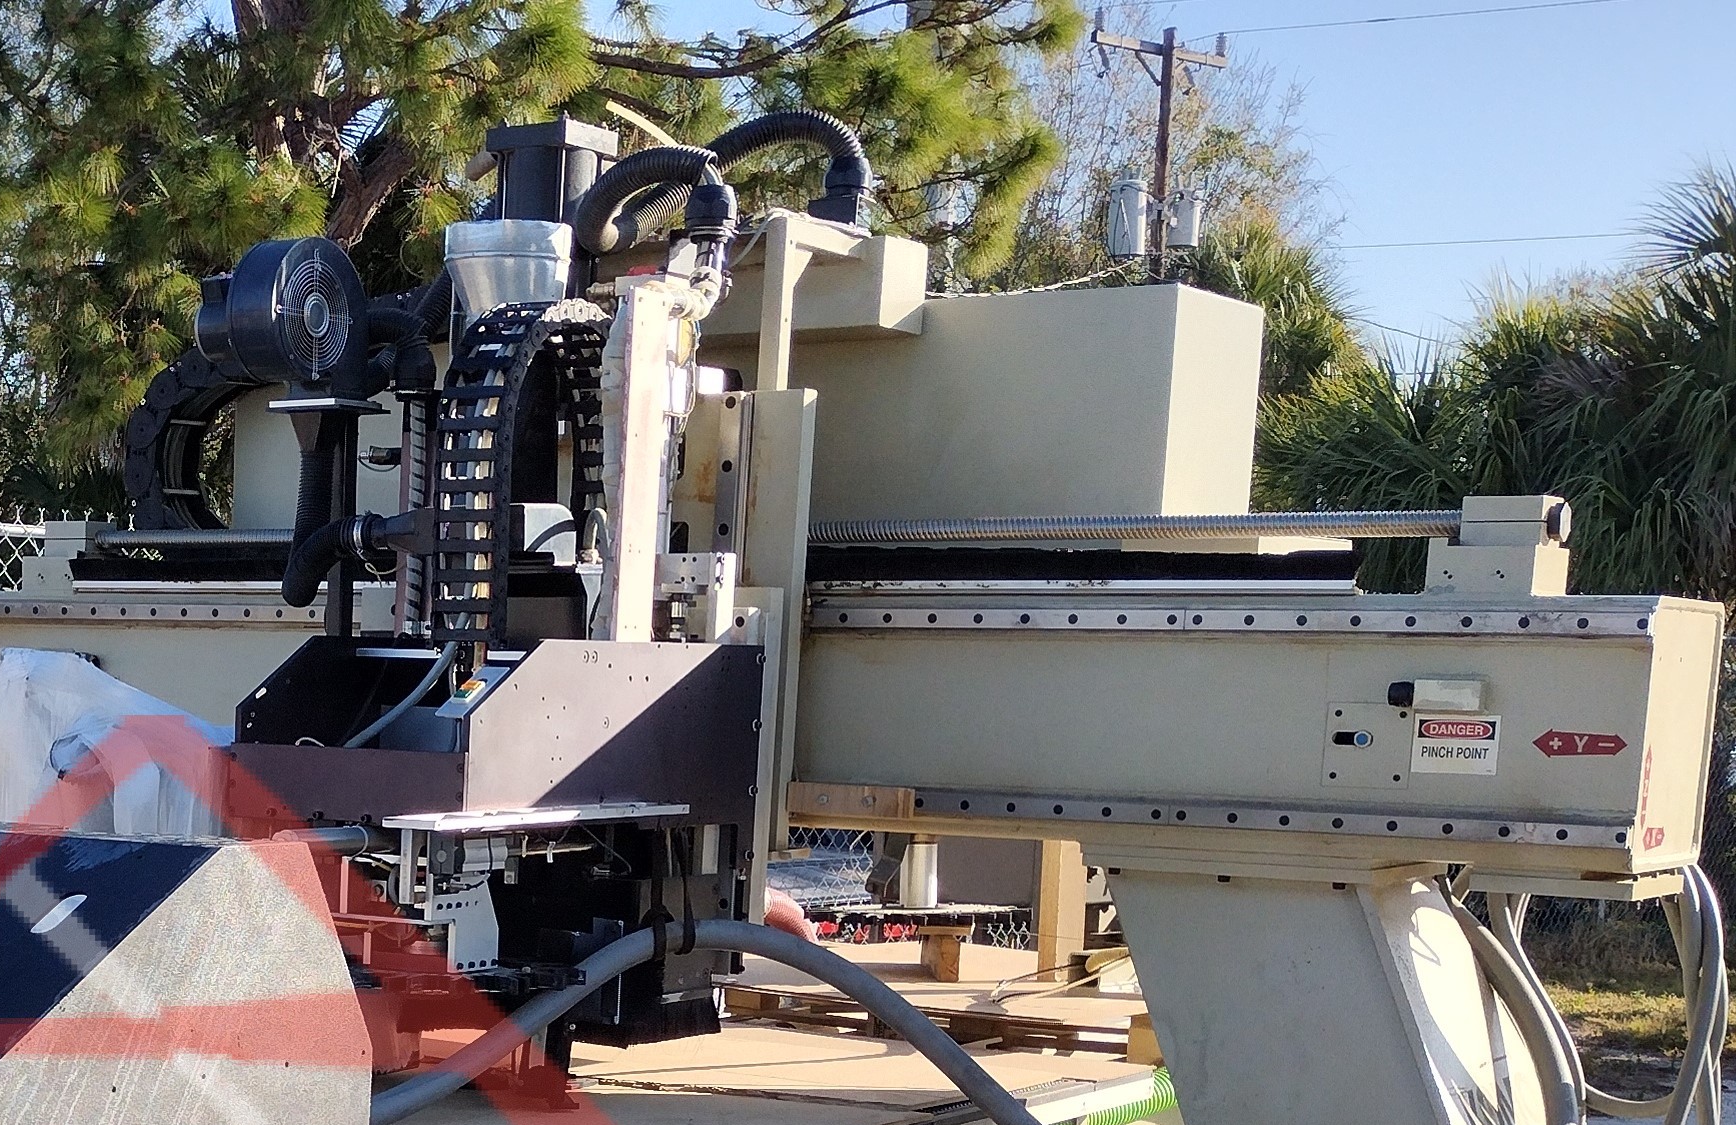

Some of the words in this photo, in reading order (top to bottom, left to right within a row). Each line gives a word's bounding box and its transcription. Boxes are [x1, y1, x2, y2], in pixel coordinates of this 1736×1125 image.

[1429, 724, 1484, 736] DANGER
[1573, 735, 1589, 753] Y
[1421, 745, 1454, 758] PINCH
[1456, 747, 1489, 760] POINT
